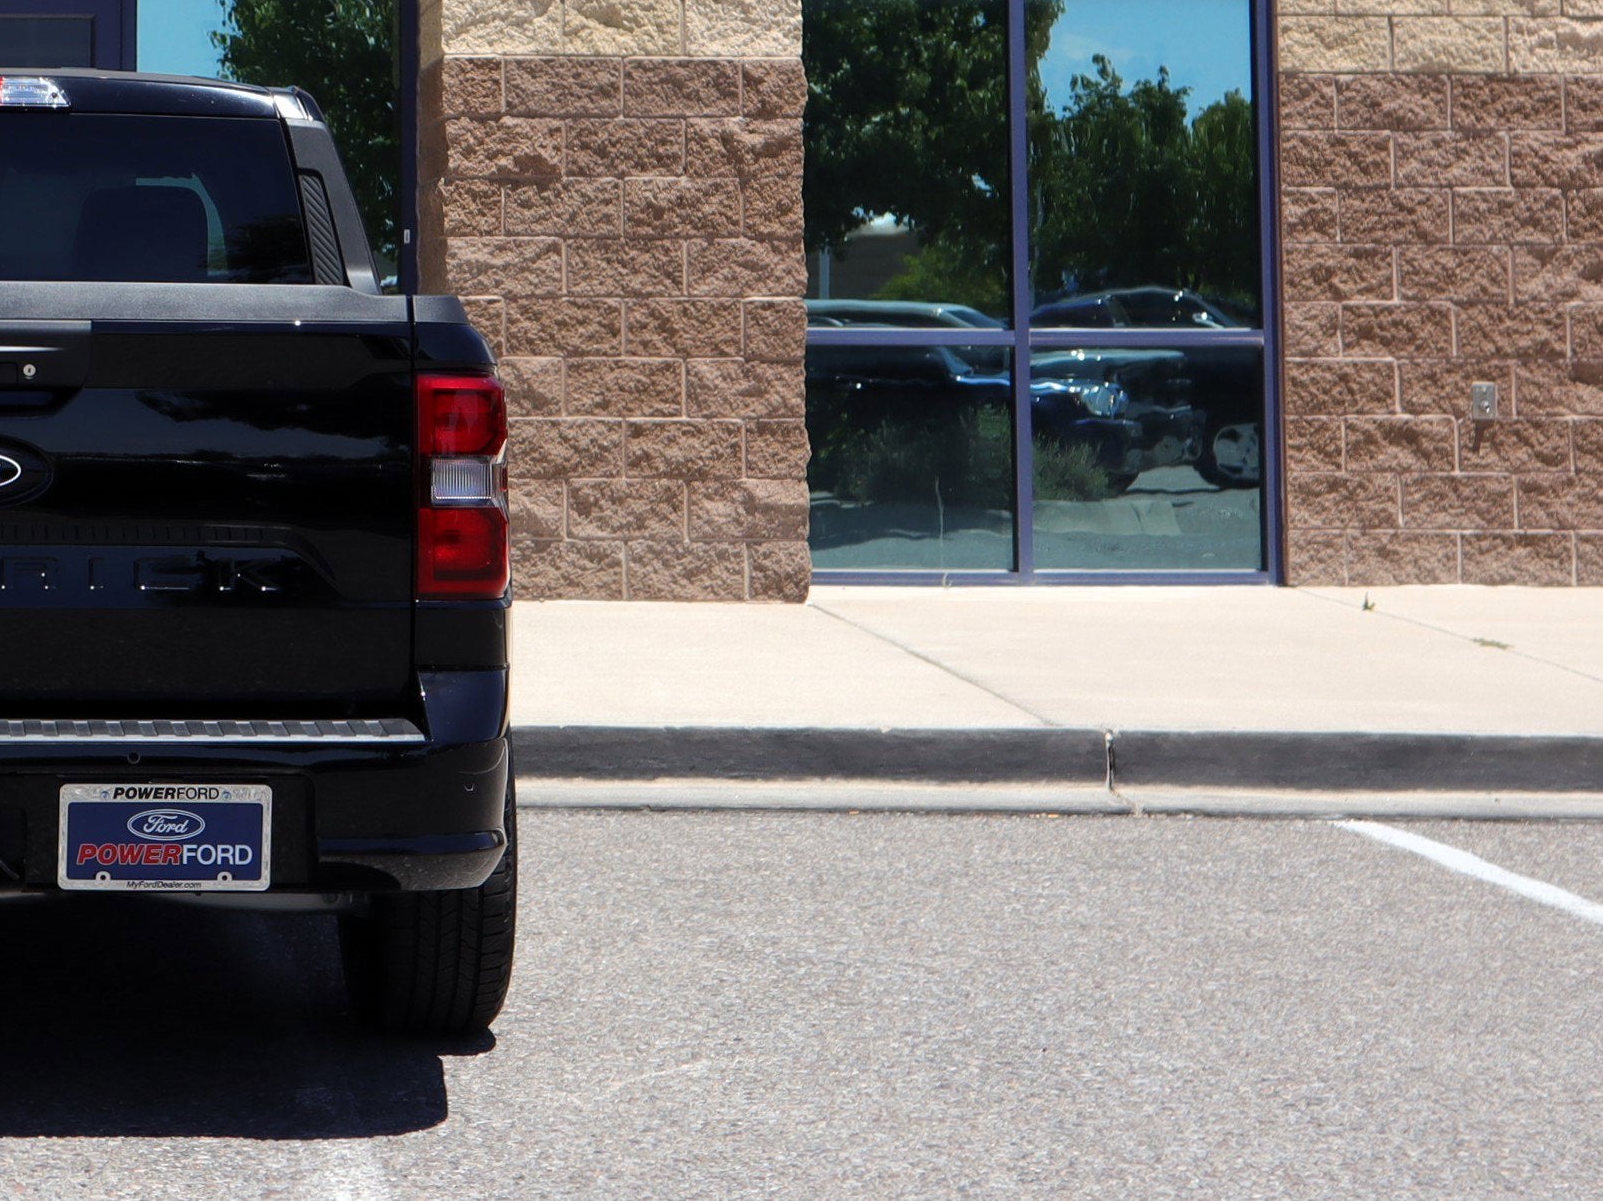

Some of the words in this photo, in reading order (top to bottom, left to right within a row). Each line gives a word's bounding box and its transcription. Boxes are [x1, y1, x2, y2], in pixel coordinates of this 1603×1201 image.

[112, 787, 220, 800] POWERFORD
[143, 813, 189, 834] Ford
[76, 843, 253, 866] POWERFORD
[126, 880, 202, 889] MyFordDealer.com
